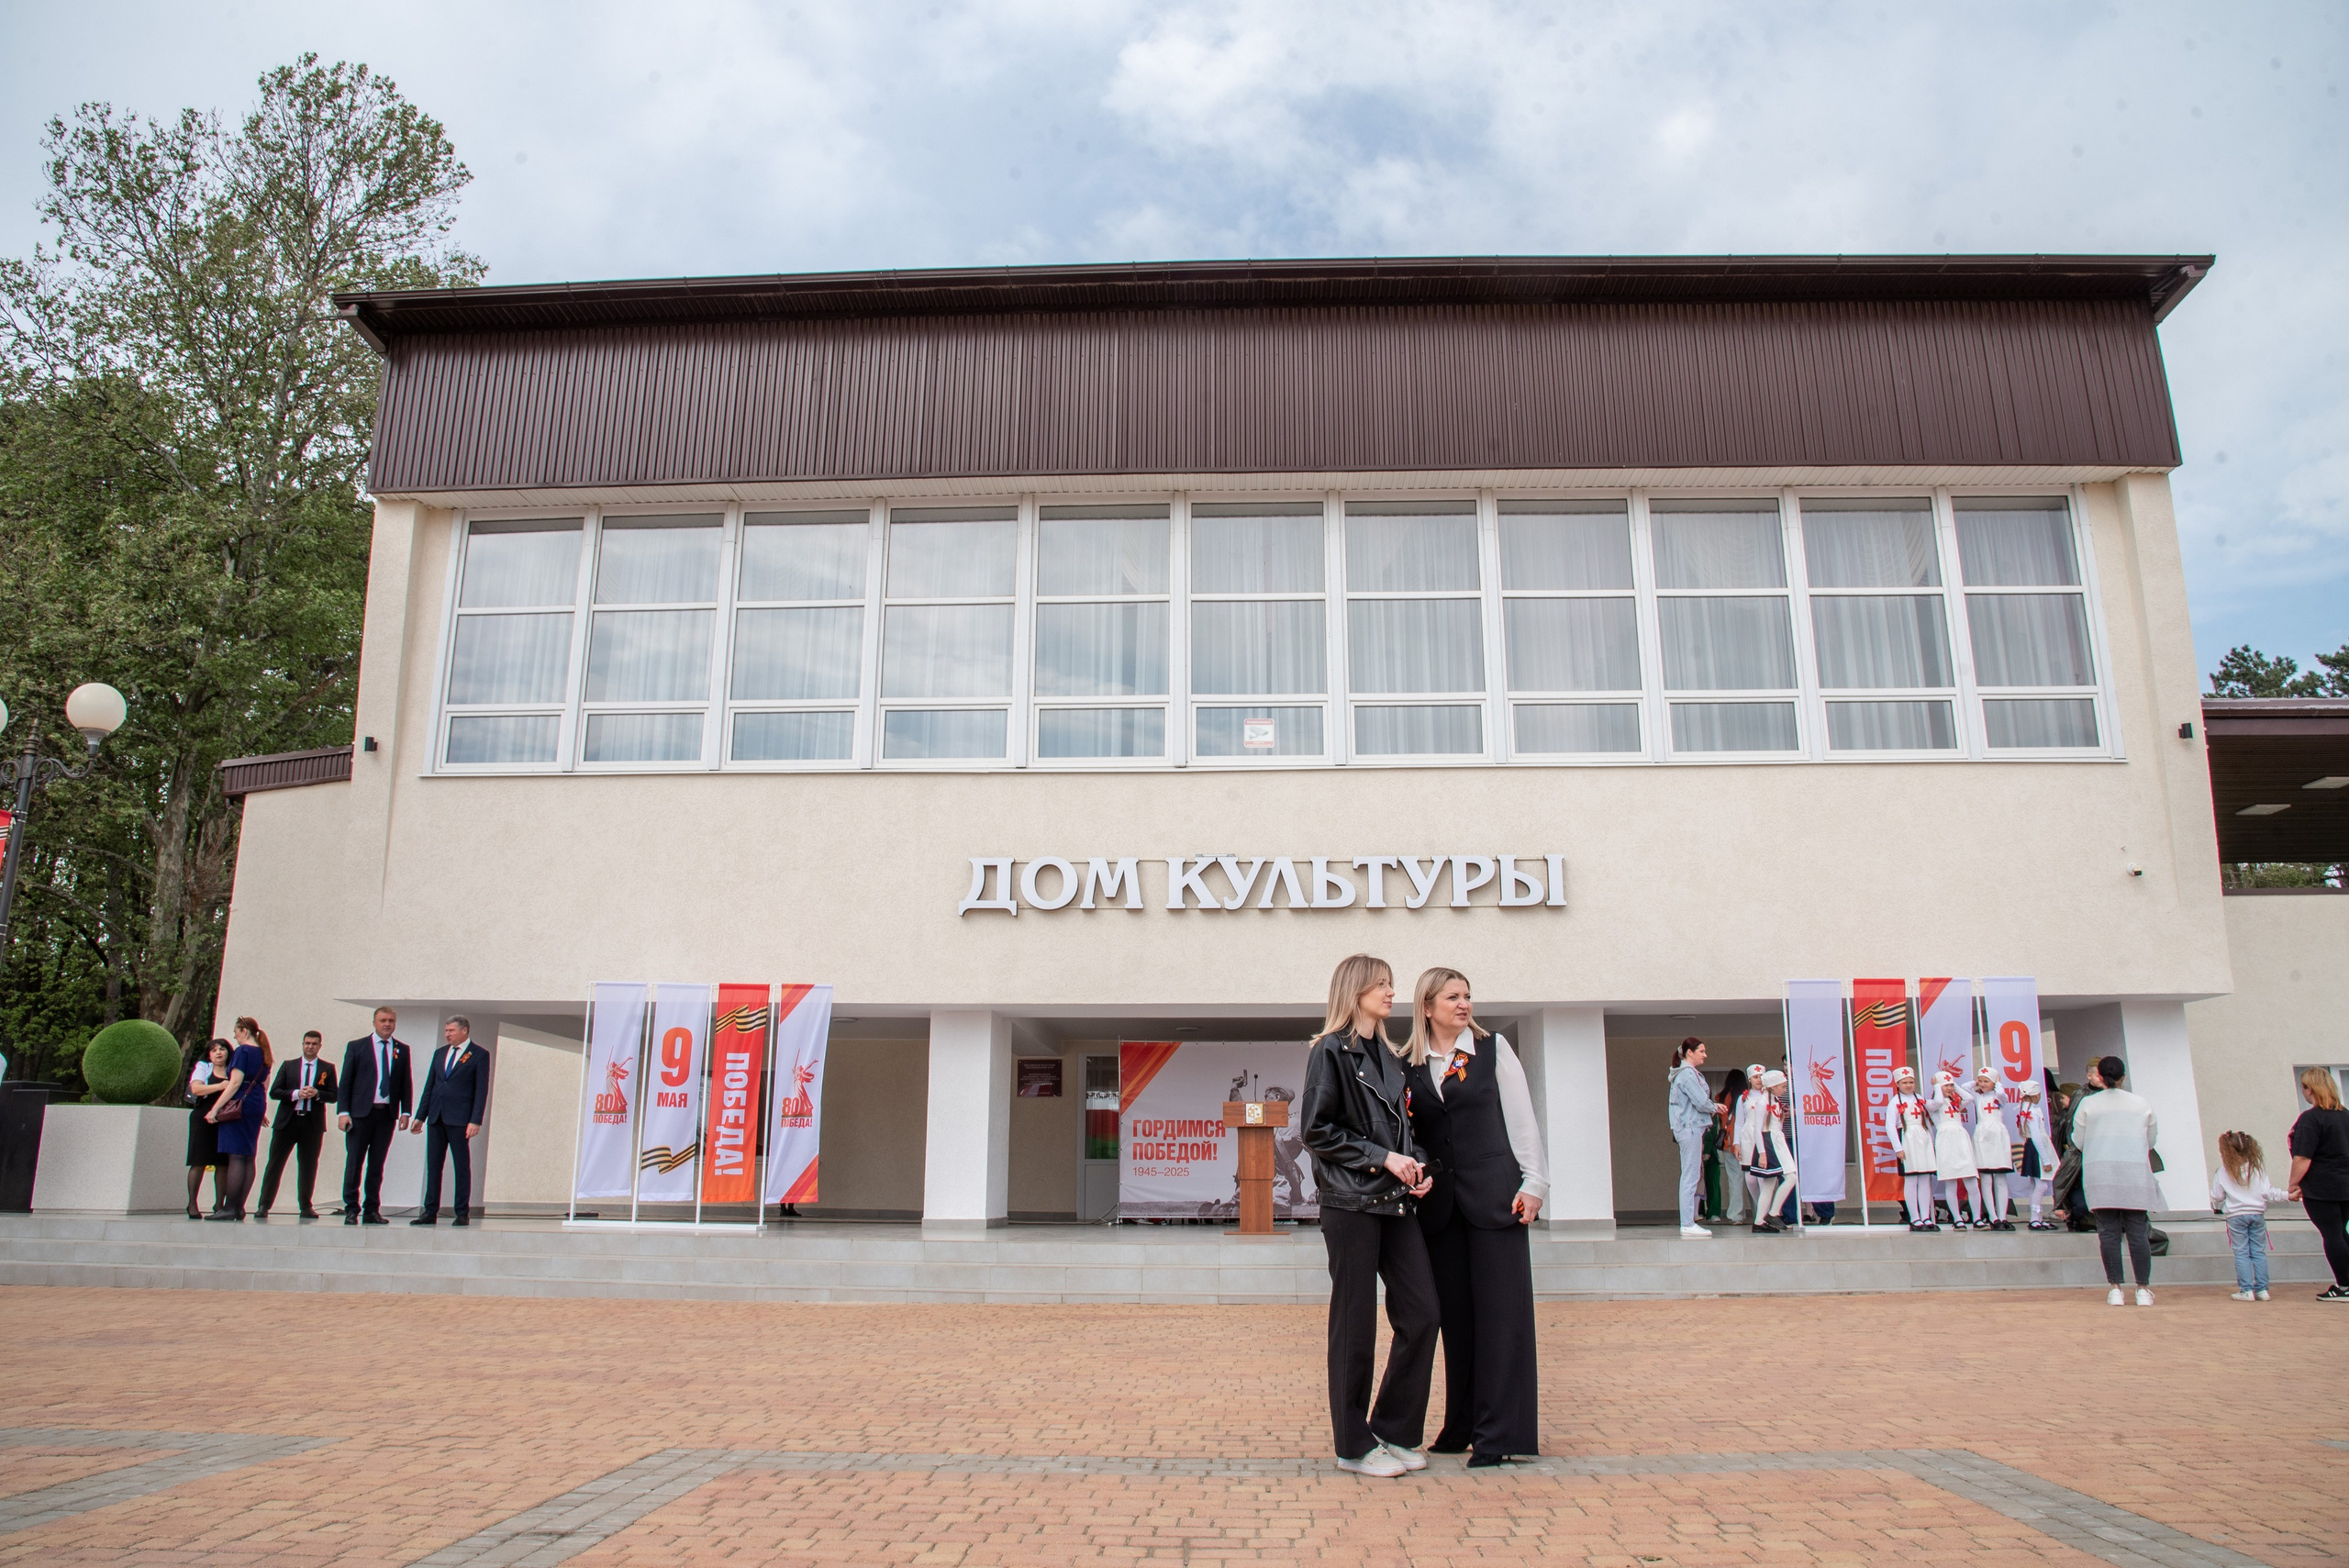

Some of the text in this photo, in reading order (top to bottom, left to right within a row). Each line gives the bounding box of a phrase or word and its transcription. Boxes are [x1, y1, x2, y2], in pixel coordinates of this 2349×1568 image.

[959, 854, 1567, 917] ДОМ КУЛЬТУРЫ
[661, 1027, 693, 1087] 9
[1999, 1020, 2032, 1083] 9
[595, 1093, 614, 1111] 80
[657, 1092, 688, 1108] МАЯ
[782, 1097, 799, 1115] 80
[1803, 1094, 1822, 1112] 80
[593, 1114, 628, 1125] ПОБЕДА!
[715, 1052, 750, 1176] ПОБЕДА!
[1804, 1116, 1841, 1127] ПОБЕДА!
[1865, 1049, 1898, 1173] ПОБЕДА!
[1132, 1119, 1226, 1140] ГОРДИМСЯ
[1132, 1140, 1218, 1164] ПОБЕДОЙ!
